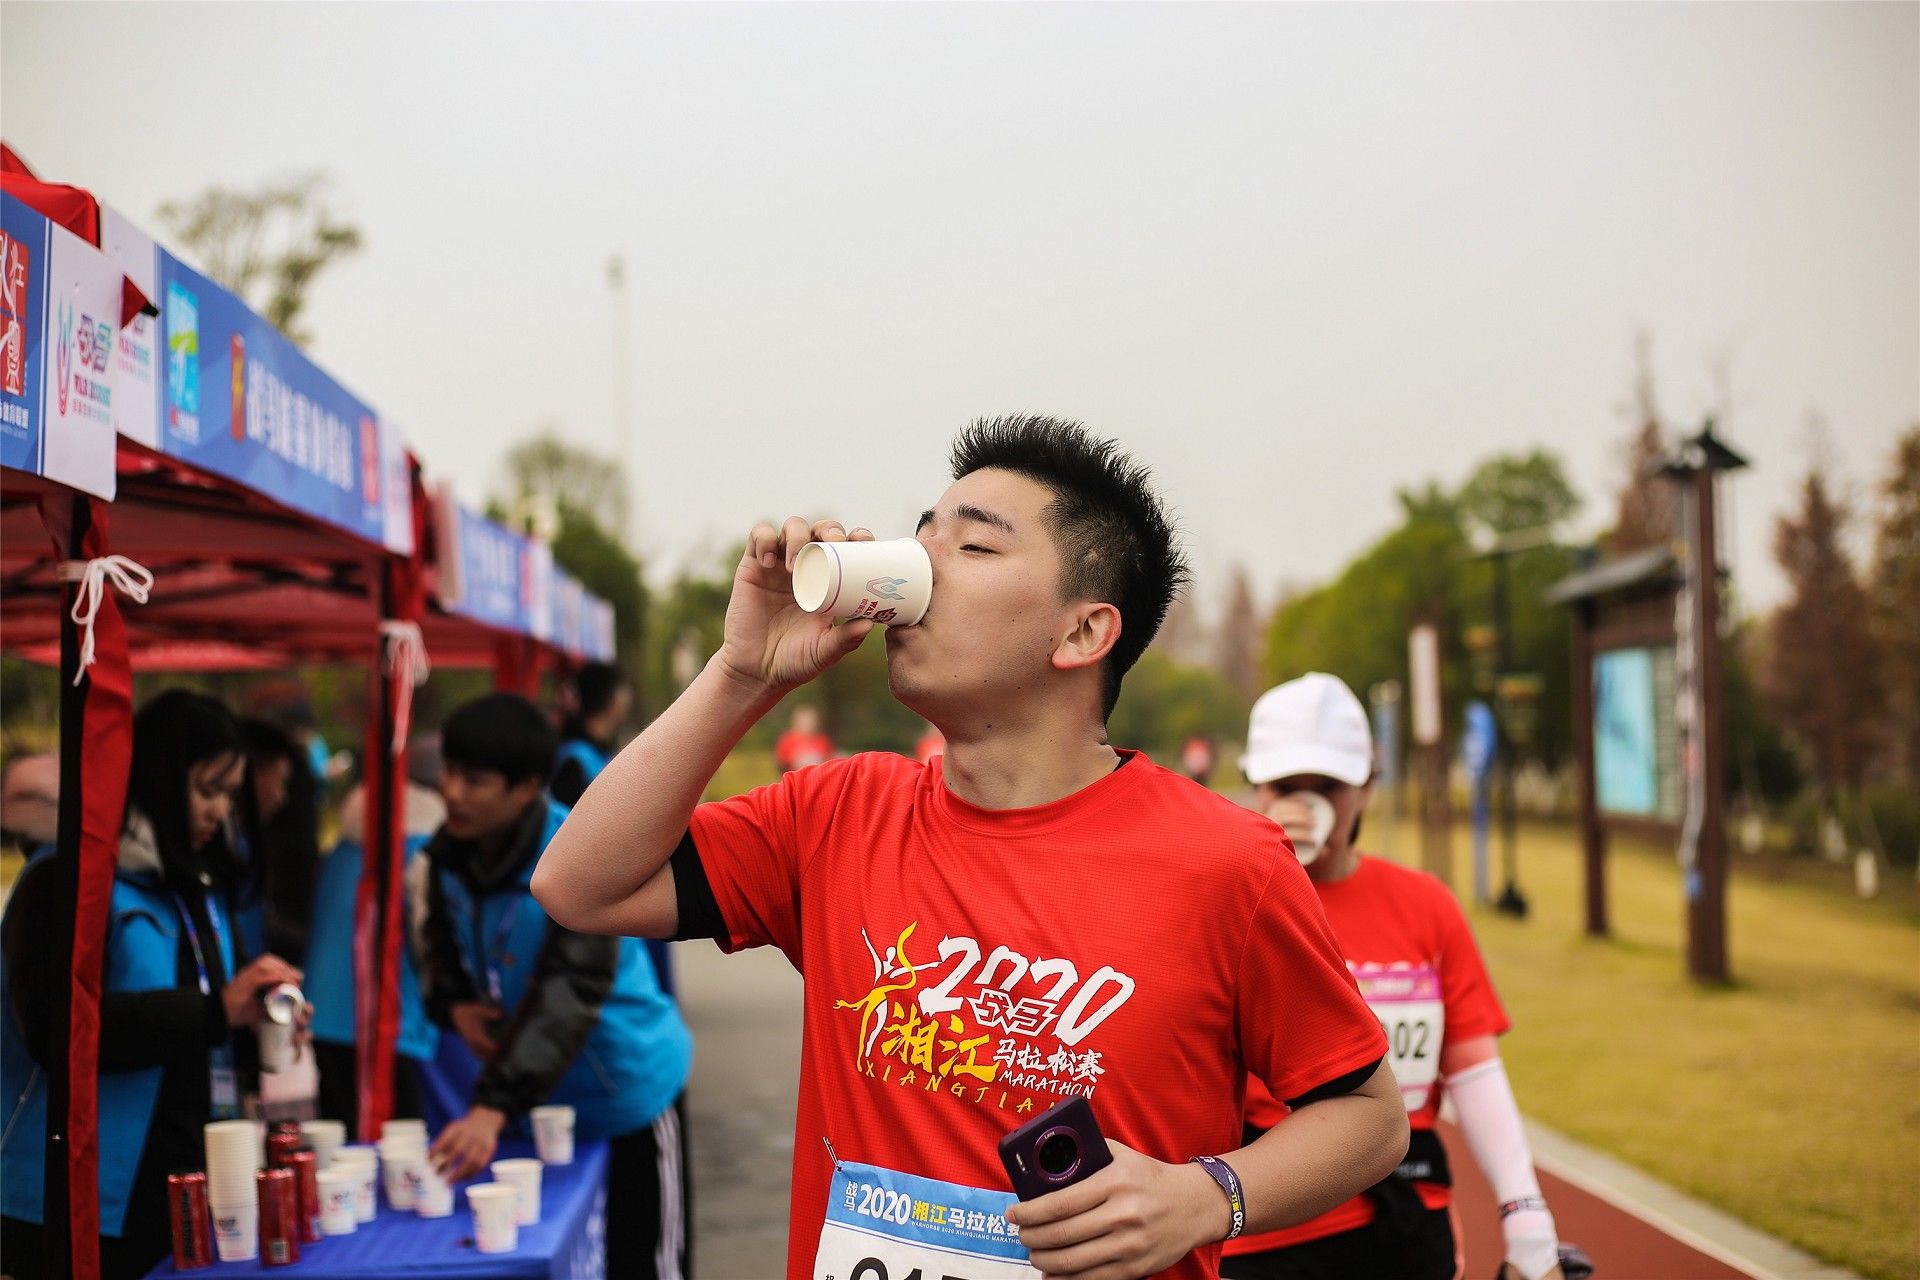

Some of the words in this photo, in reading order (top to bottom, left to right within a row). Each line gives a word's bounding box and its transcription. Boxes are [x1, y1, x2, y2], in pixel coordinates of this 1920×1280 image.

[917, 934, 1136, 1046] 2020
[882, 1001, 1000, 1083] 湘江
[992, 1038, 1106, 1084] 马拉松赛
[1383, 1020, 1430, 1060] 02
[865, 1060, 1056, 1114] XIANGJIA
[998, 1070, 1096, 1100] MARATHON
[857, 1183, 911, 1225] 2020
[992, 1235, 1022, 1245] MARATHO
